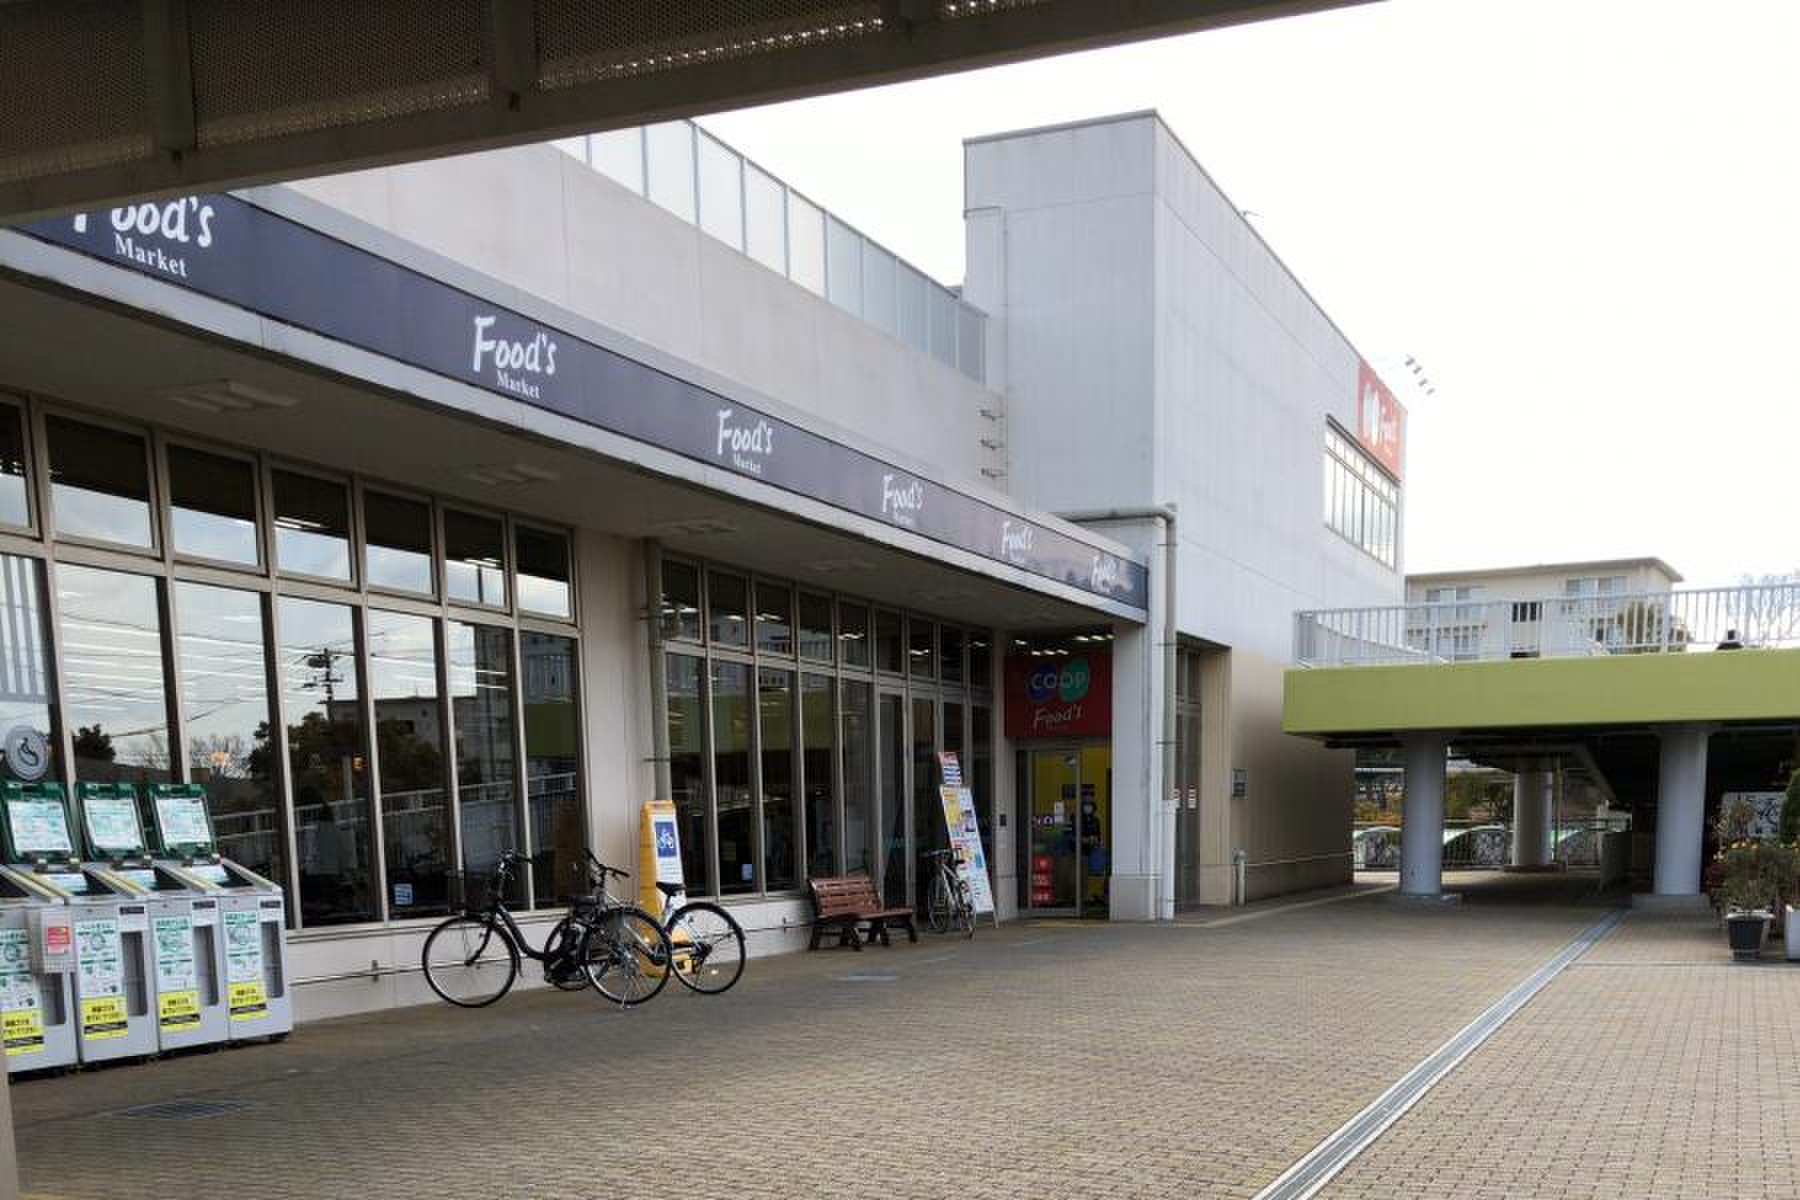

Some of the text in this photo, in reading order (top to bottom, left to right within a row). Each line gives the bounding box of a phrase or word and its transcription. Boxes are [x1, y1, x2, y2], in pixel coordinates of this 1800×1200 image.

[114, 232, 188, 277] Market
[473, 315, 558, 375] Food's
[717, 409, 773, 455] Food's
[883, 474, 923, 512] Food's
